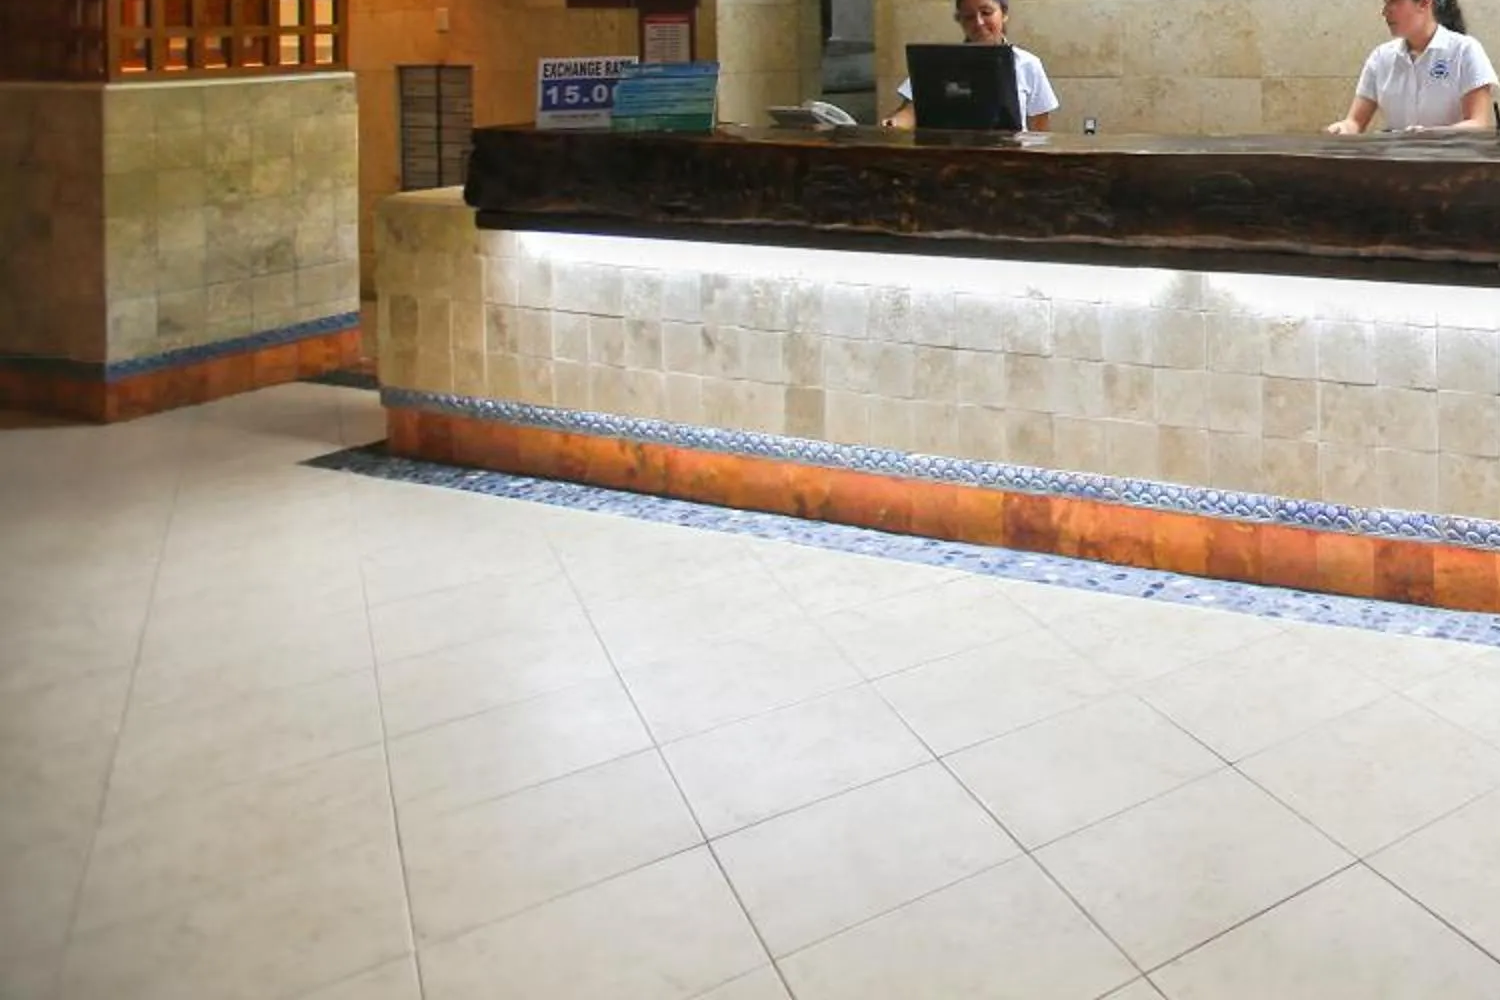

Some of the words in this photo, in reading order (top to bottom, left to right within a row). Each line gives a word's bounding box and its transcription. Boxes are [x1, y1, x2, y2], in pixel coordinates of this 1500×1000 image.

[543, 61, 602, 78] EXCHANGE
[605, 60, 633, 76] RAT
[546, 84, 618, 105] 15.0
